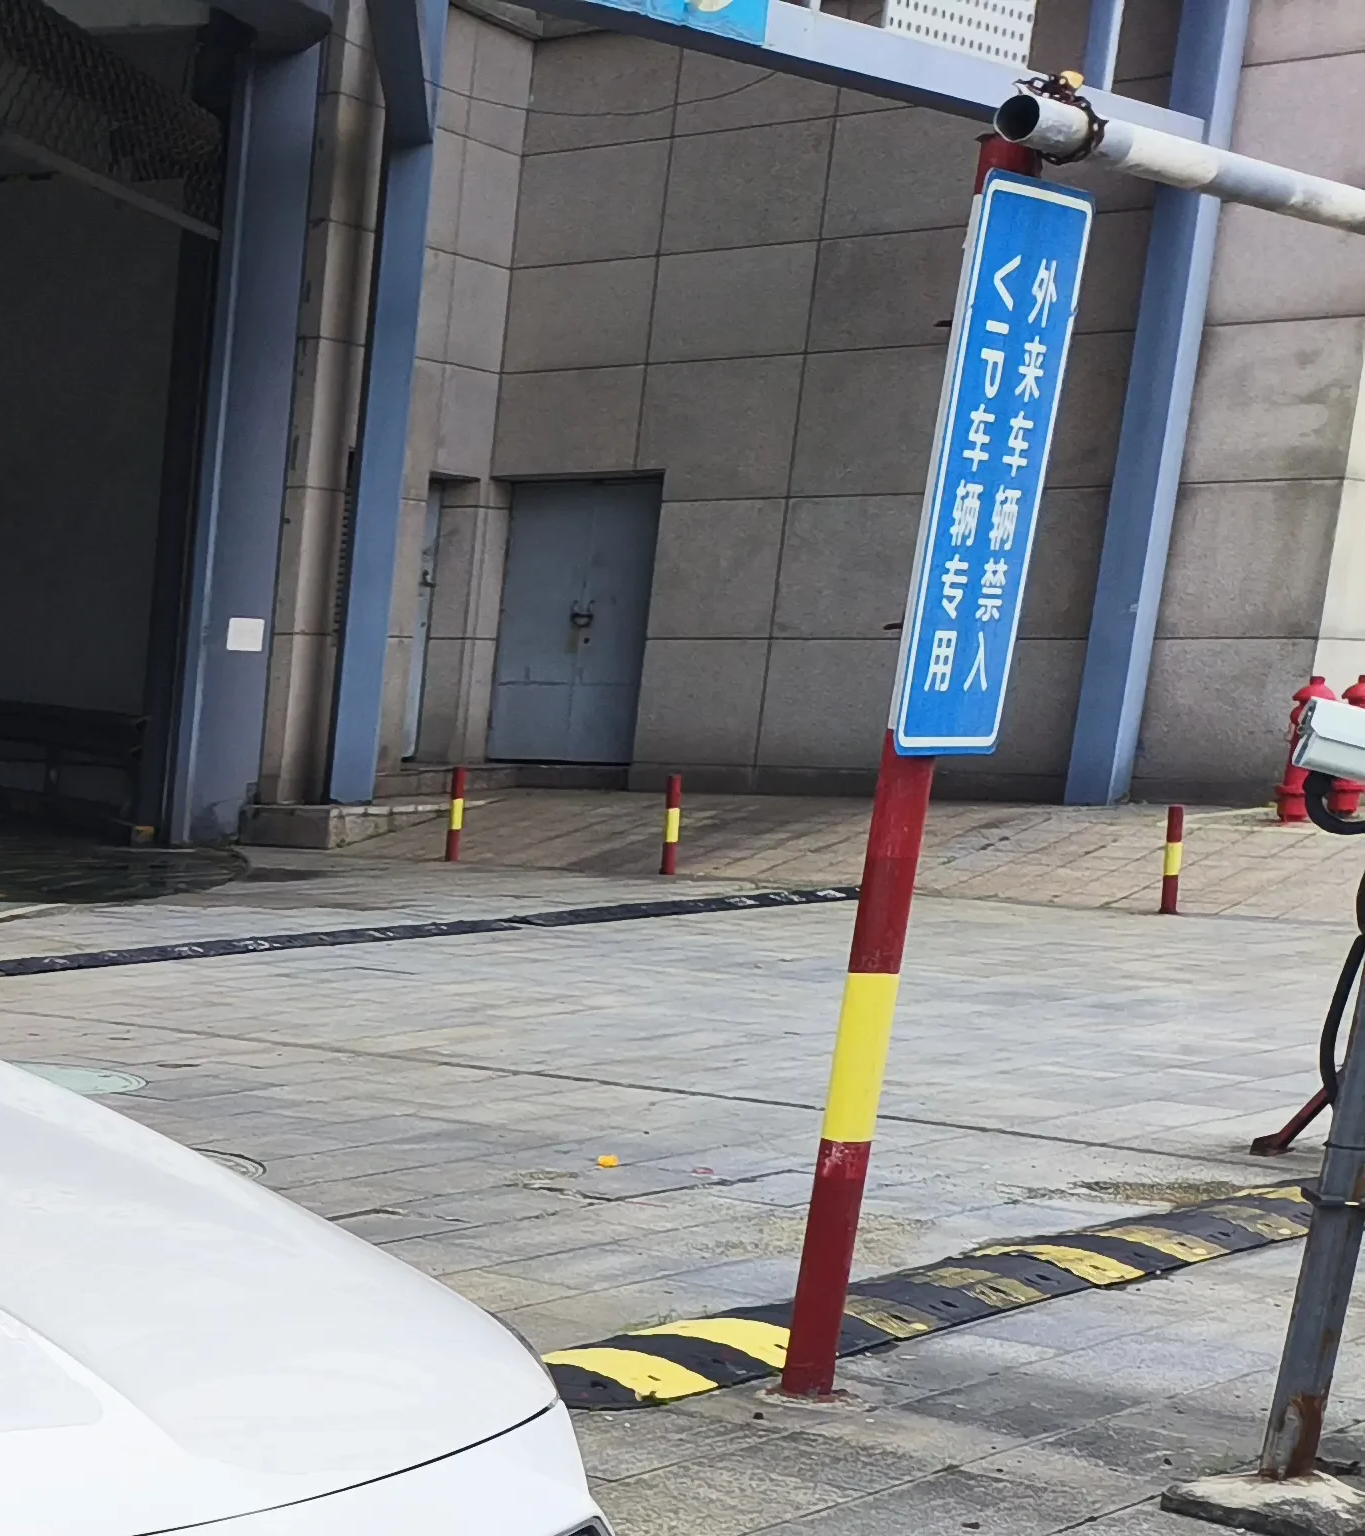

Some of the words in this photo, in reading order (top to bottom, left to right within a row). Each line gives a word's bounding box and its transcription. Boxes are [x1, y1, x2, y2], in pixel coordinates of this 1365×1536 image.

[964, 259, 1058, 693] 外来车辆禁入
